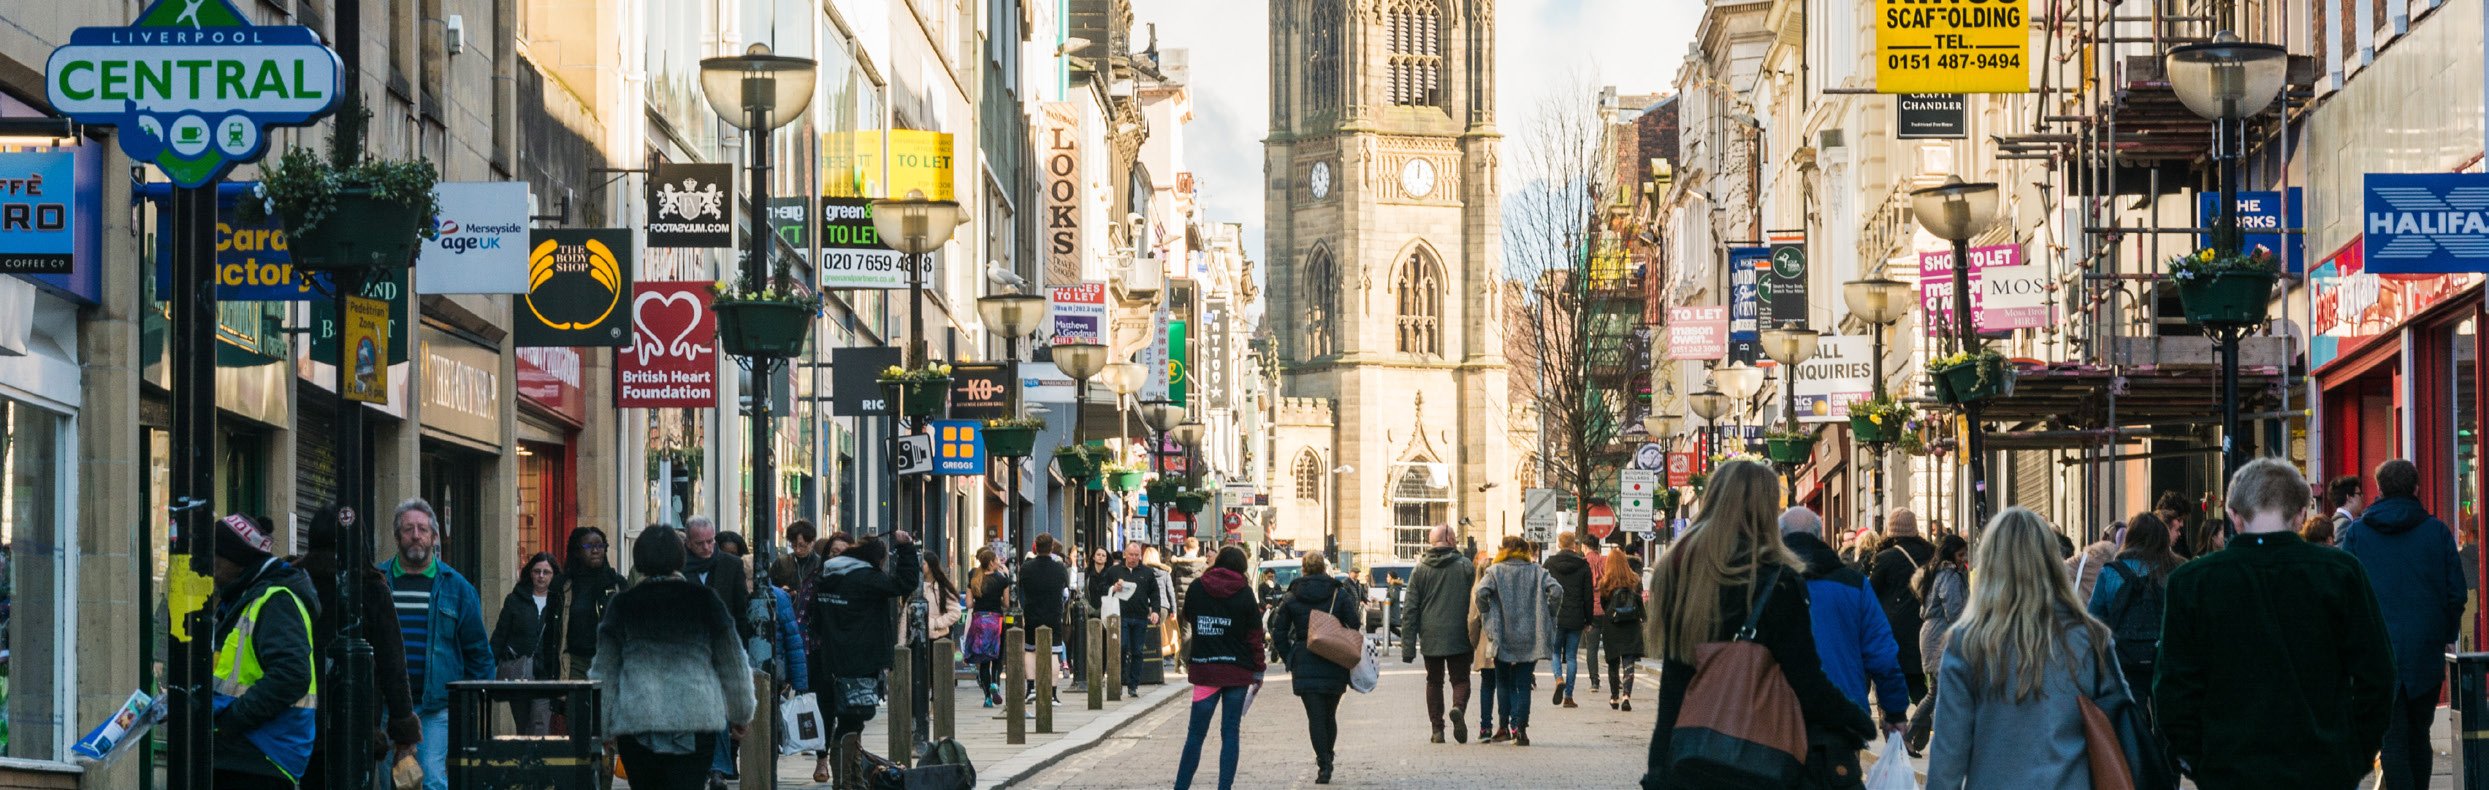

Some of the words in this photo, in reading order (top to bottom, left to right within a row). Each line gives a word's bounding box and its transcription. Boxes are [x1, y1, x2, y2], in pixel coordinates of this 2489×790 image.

[112, 31, 263, 44] LIVERPOOL
[1934, 34, 1974, 49] TEL.
[1888, 54, 1930, 69] 0151
[1937, 53, 2021, 69] 487-9494
[58, 60, 322, 101] CENTRAL
[897, 154, 918, 168] TO
[923, 155, 951, 169] LET
[1050, 127, 1077, 255] LOOKS
[2236, 199, 2261, 212] HE
[466, 223, 522, 234] Merseyside
[827, 225, 848, 244] TO
[852, 226, 878, 245] LET
[559, 245, 585, 254] THE
[5, 259, 45, 269] COFFEE
[556, 254, 588, 263] BODY
[823, 252, 851, 270] 020
[856, 253, 892, 272] 7659
[895, 256, 933, 273] 488
[1924, 253, 1954, 272] SHO
[1986, 249, 2012, 265] LET
[556, 263, 589, 272] SHOP
[1056, 292, 1071, 301] TO
[1074, 292, 1096, 302] LET
[1671, 309, 1692, 321] TO
[1695, 308, 1723, 320] LET
[2004, 310, 2025, 318] Moss
[1055, 320, 1089, 330] Matthews
[2014, 317, 2037, 326] HIRE
[1671, 326, 1714, 336] mason
[1211, 309, 1221, 384] TATTOO
[1812, 343, 1843, 360] ALL
[622, 370, 667, 383] British
[671, 370, 711, 383] Heart
[1793, 363, 1871, 381] NQUIRIES
[622, 385, 711, 399] Foundation
[942, 462, 973, 470] GREGGS
